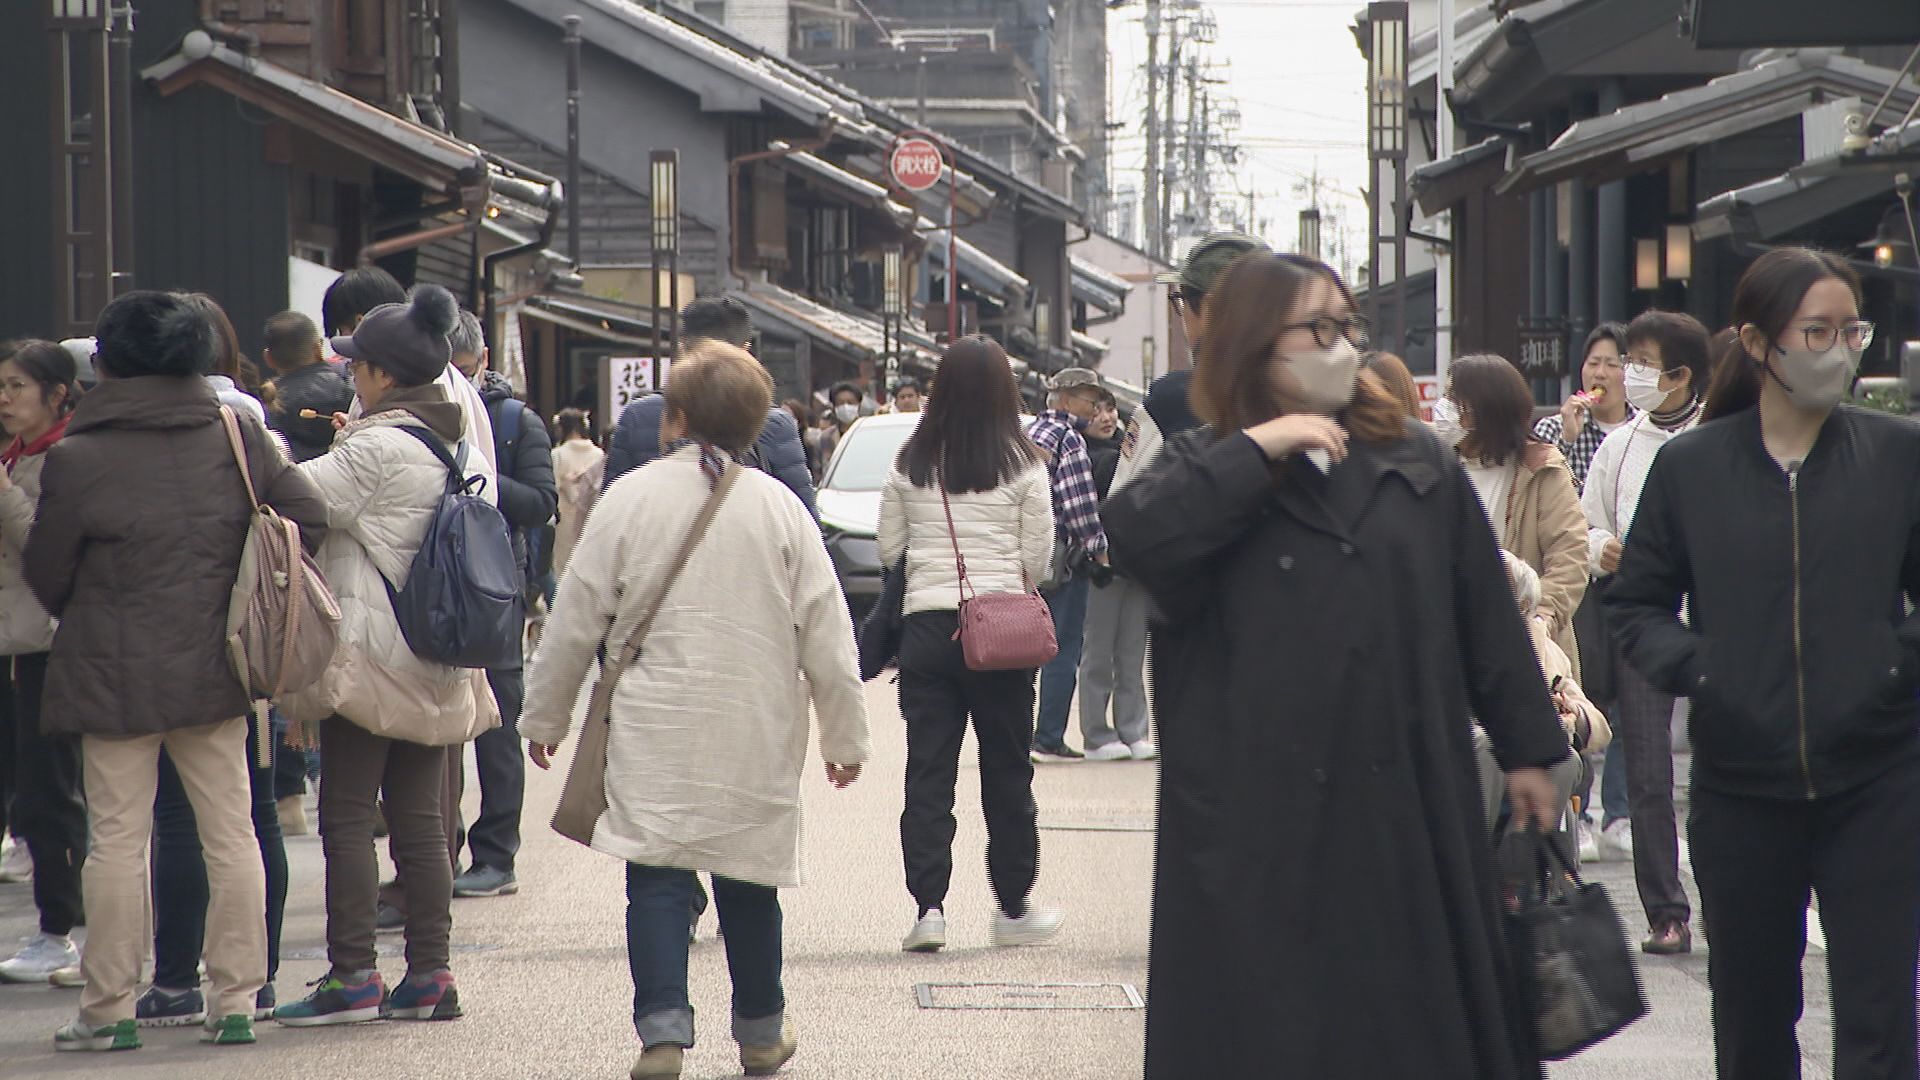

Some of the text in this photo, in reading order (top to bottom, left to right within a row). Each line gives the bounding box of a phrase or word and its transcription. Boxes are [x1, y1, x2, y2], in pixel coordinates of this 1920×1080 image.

[896, 154, 937, 176] 消火栓
[1520, 337, 1561, 371] 珈琲
